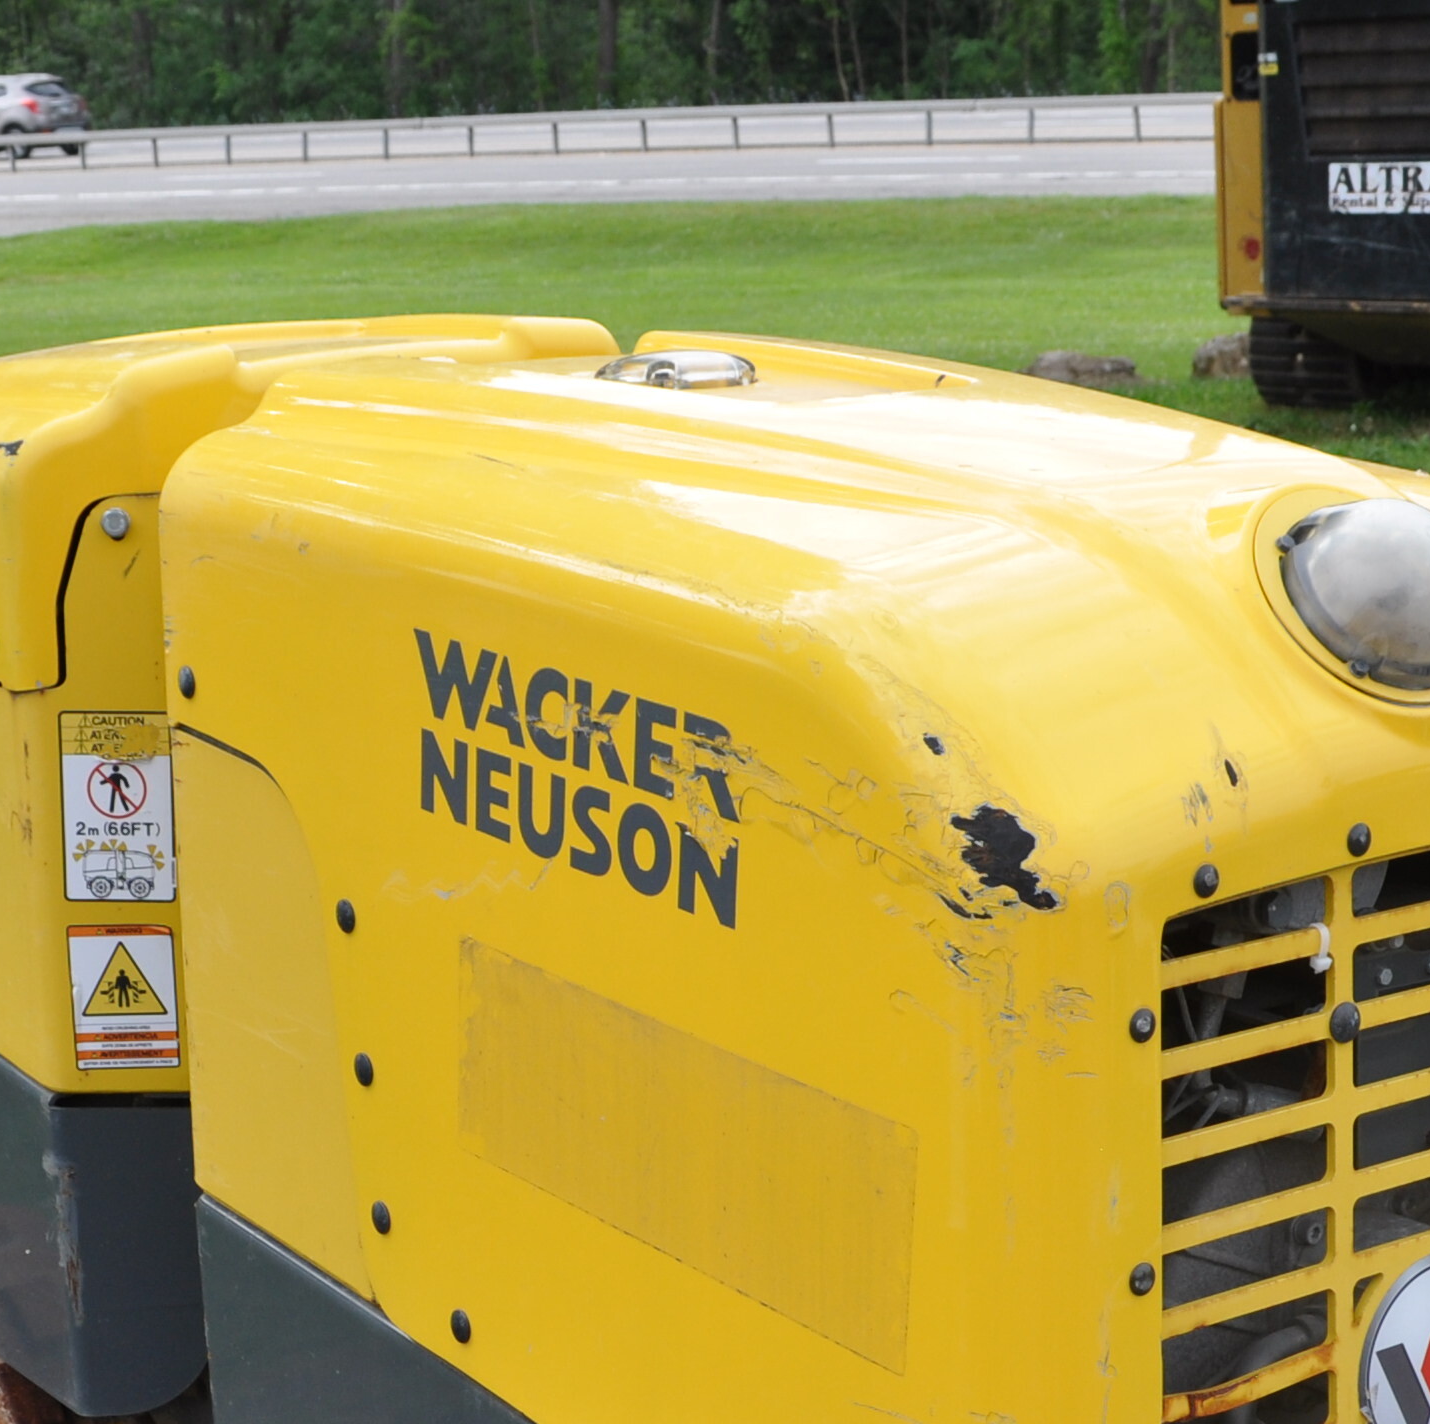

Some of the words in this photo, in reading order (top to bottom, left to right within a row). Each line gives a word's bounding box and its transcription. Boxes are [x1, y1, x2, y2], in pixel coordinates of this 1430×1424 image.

[91, 716, 145, 726] CAUTION
[413, 627, 741, 824] WACKER
[421, 727, 739, 930] NEUSON
